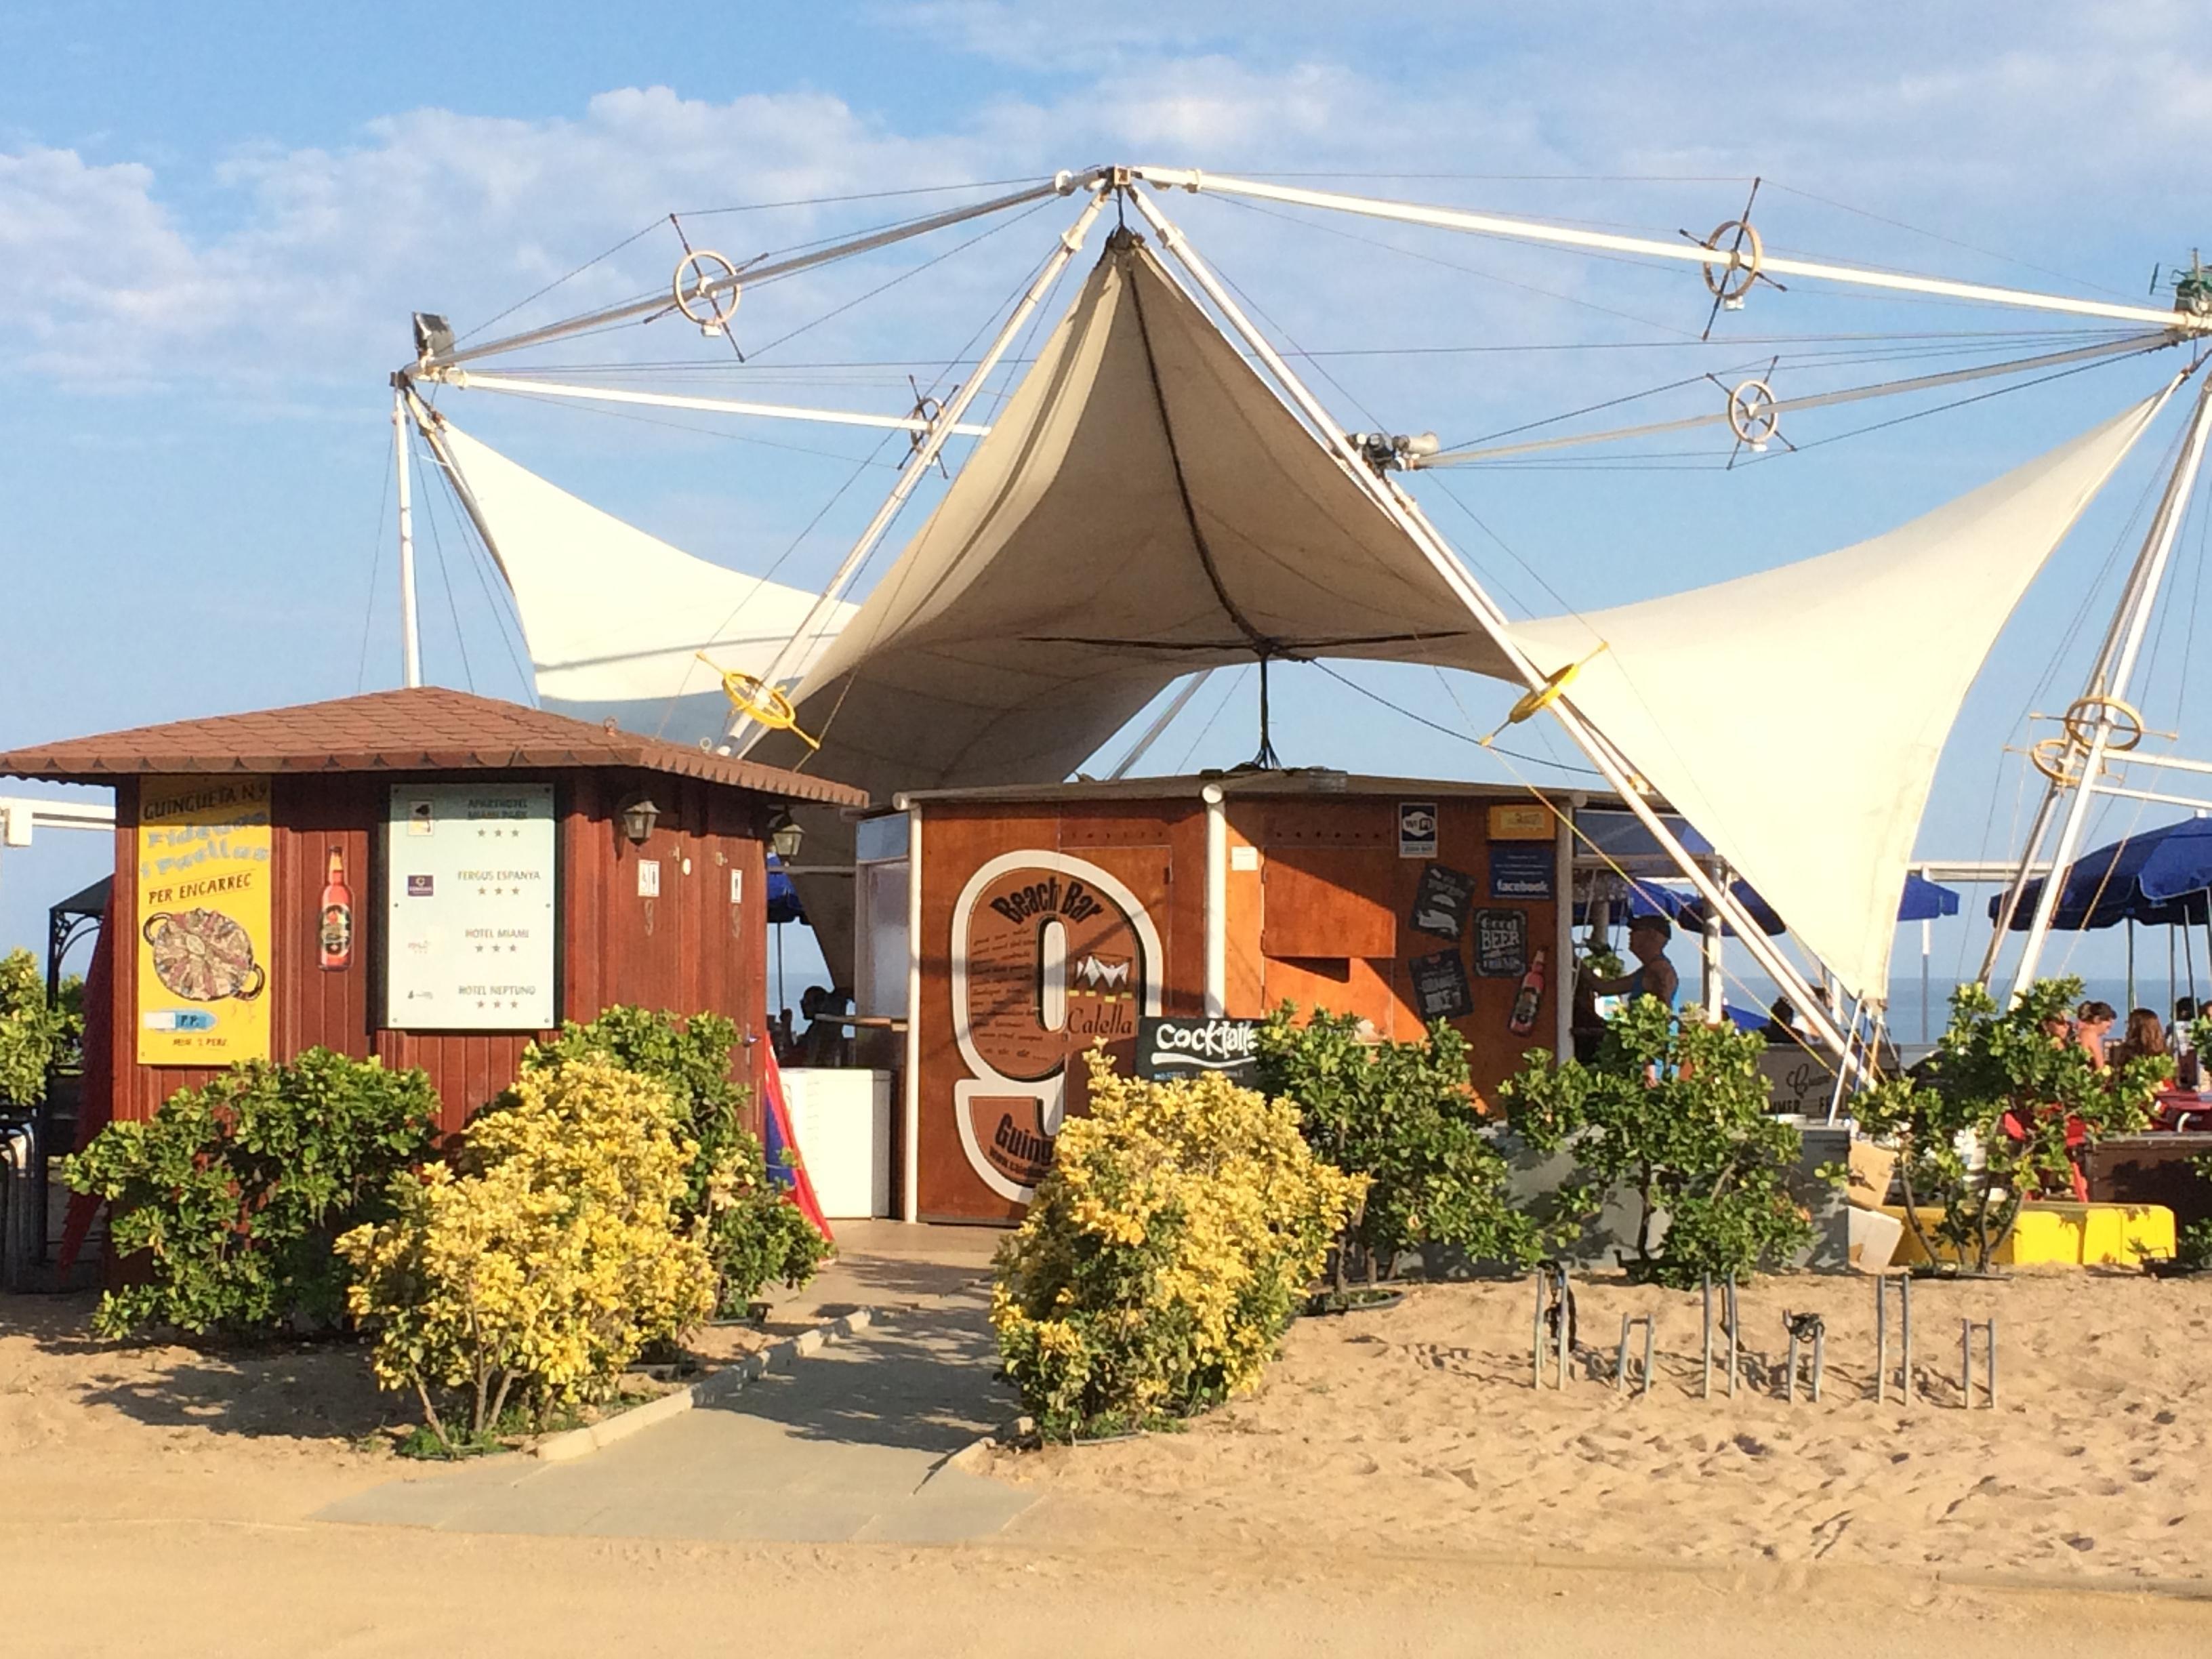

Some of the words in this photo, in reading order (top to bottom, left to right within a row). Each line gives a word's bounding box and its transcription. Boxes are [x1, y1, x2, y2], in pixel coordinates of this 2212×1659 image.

[457, 871, 494, 881] FERGUS
[497, 871, 541, 881] ESPANYA
[148, 888, 173, 905] PER
[176, 873, 252, 899] ENCARREC
[1496, 879, 1550, 893] facebook
[989, 876, 1061, 925] Beach
[1060, 881, 1104, 924] Bar
[465, 928, 494, 938] HOTEL
[497, 928, 530, 938] MIAMI
[1480, 929, 1520, 950] BEER
[458, 985, 487, 996] HOTEL
[489, 985, 537, 996] NEPTUNO
[1067, 1004, 1133, 1035] Calella
